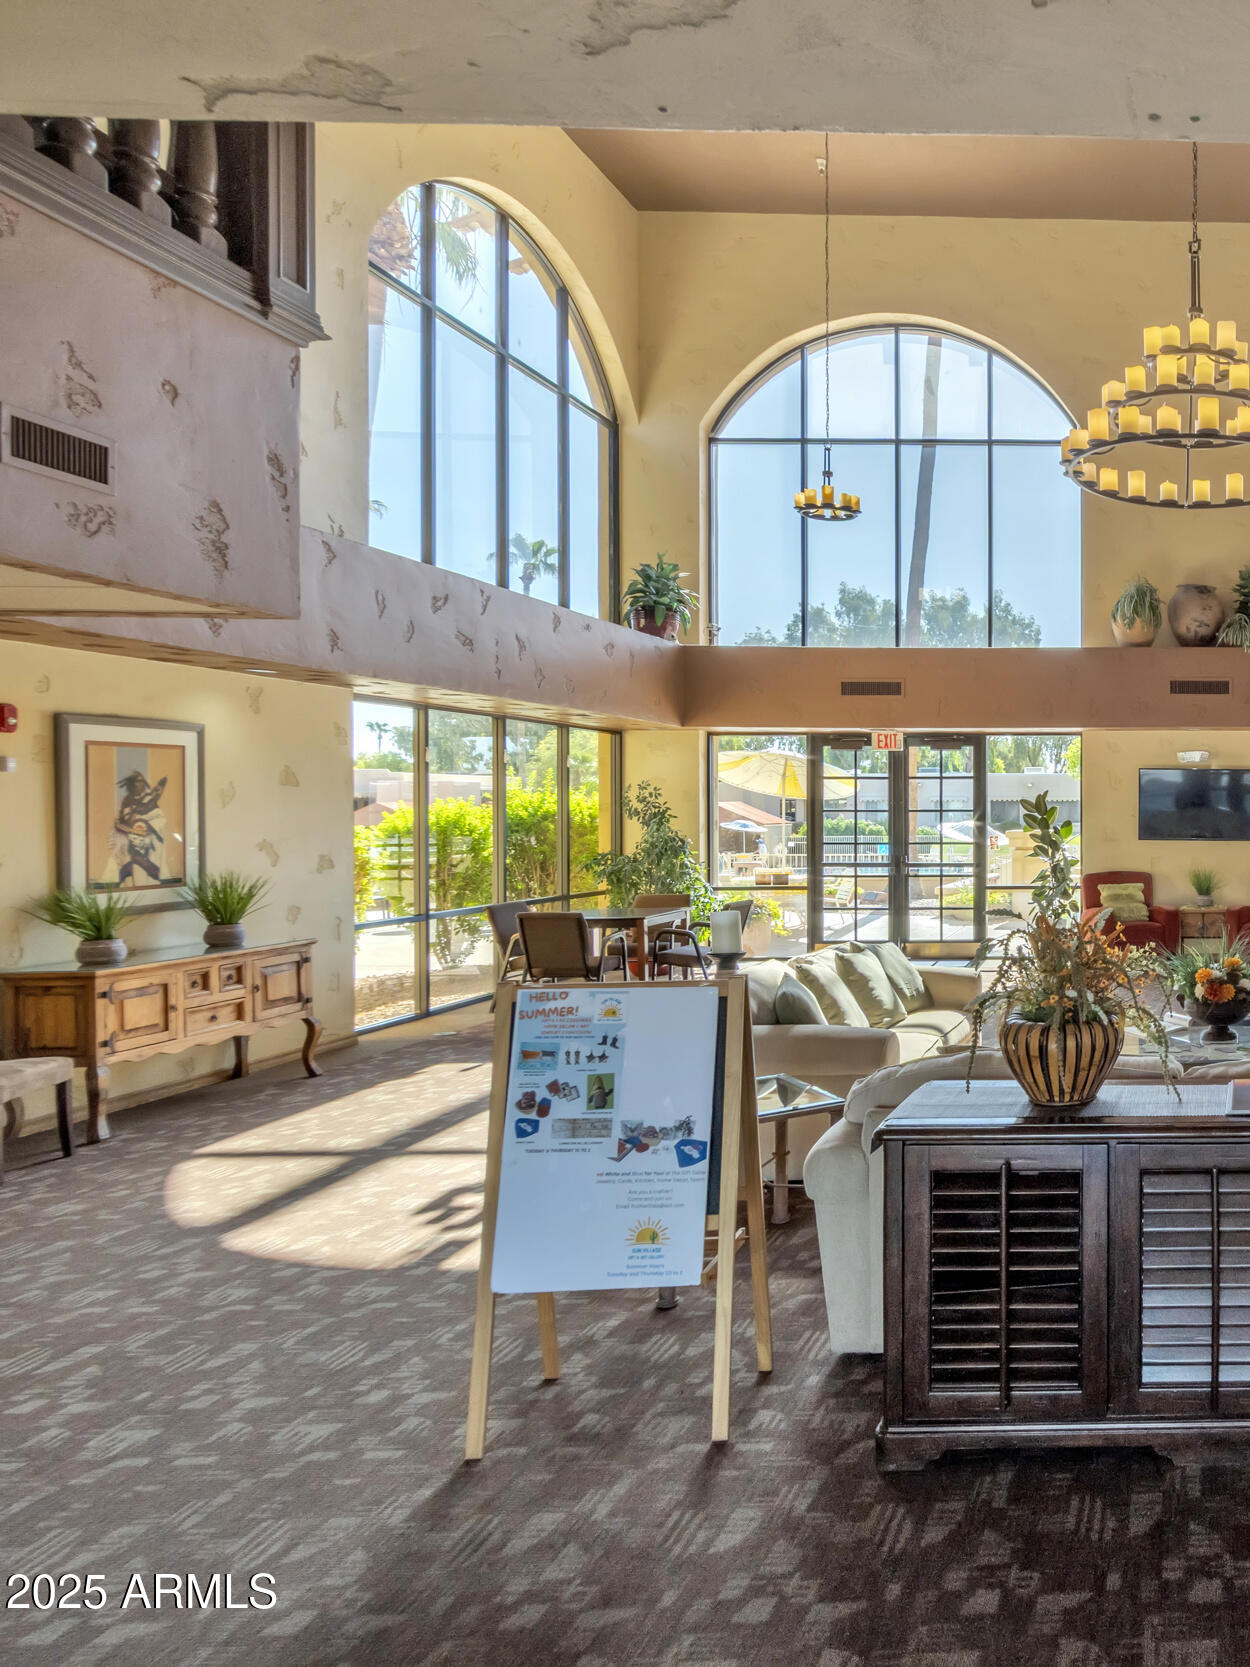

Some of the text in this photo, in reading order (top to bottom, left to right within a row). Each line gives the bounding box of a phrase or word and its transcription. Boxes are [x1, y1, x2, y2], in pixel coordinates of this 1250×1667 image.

[877, 733, 897, 749] EXIT
[529, 991, 569, 1002] HELLO
[518, 1006, 580, 1020] SUMMER!
